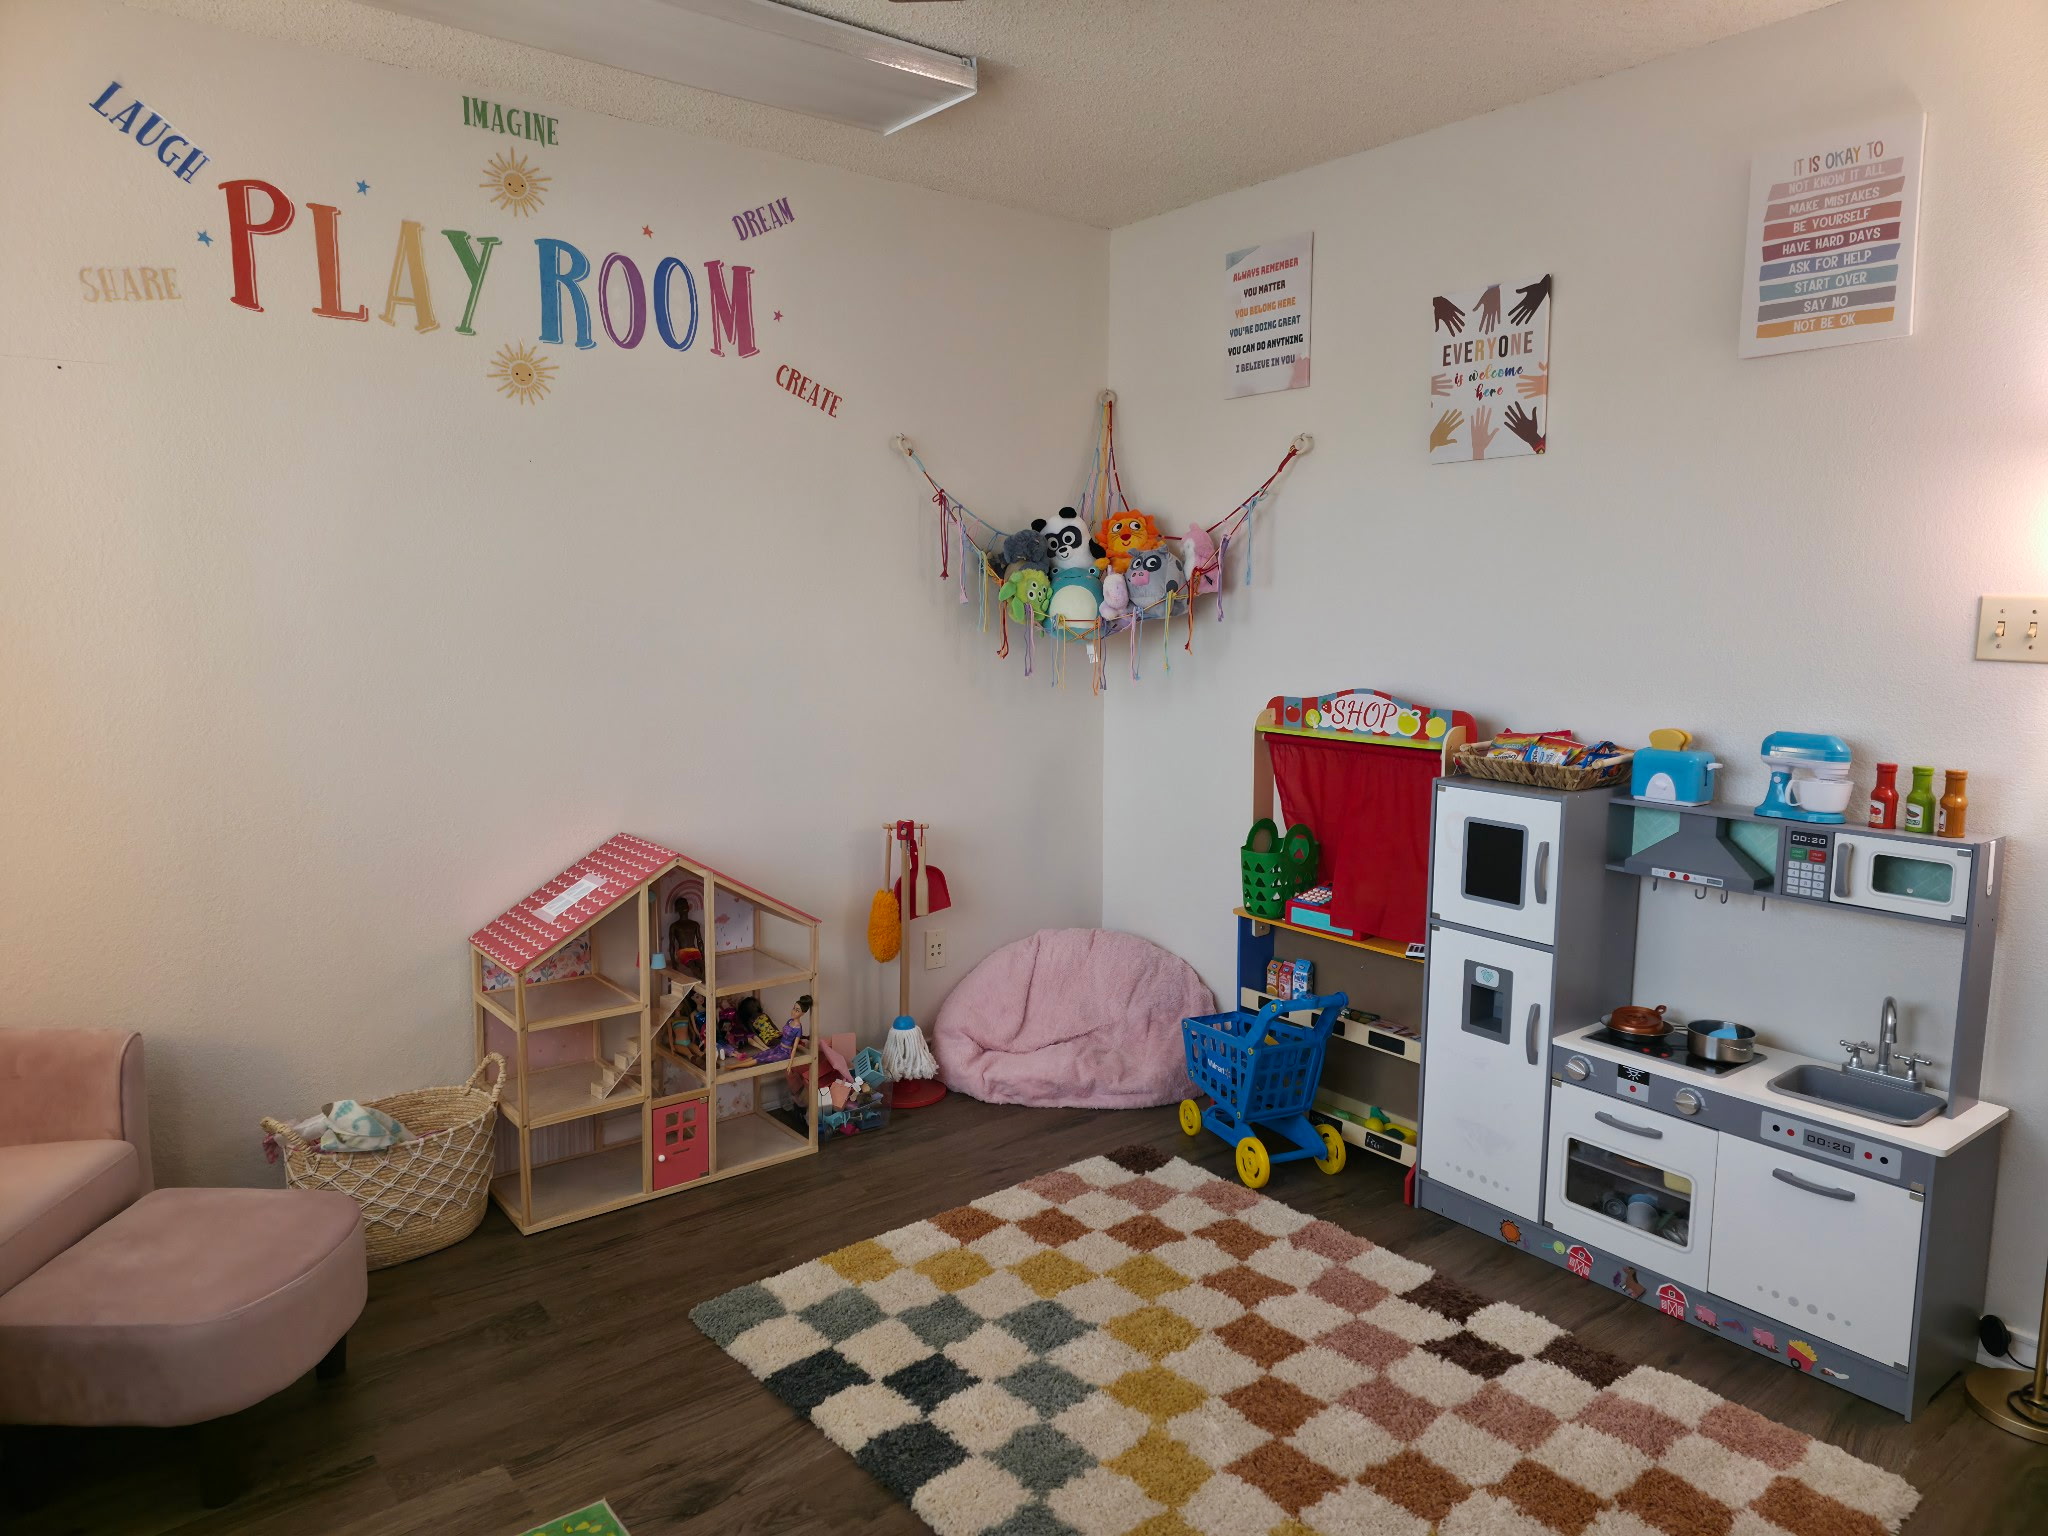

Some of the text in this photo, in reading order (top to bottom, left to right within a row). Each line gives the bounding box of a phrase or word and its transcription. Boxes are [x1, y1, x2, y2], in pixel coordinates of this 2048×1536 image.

[89, 81, 211, 184] LAUGH
[461, 94, 561, 149] IMAGINE
[1793, 140, 1884, 177] IT IS OKAY TO
[1789, 163, 1885, 195] NOT KNOW IT ALL
[1789, 186, 1880, 215] MAKE MISTAKES
[731, 197, 795, 241] DREAM
[1793, 207, 1871, 234] BE YOURSELF
[1782, 227, 1881, 255] HAVE HARD DAYS
[218, 178, 761, 360] PLAY ROOM
[1233, 257, 1299, 282] ALWAYS REMEMBER
[1789, 249, 1872, 275] ASK FOR HELP
[79, 266, 183, 304] SHARE
[1243, 279, 1286, 298] YOU MATTER
[1794, 271, 1867, 294] START OVER
[1235, 296, 1296, 319] YOU BELONG HERE
[1803, 295, 1849, 313] SAY NO
[1230, 314, 1301, 338] YOU'RE DOING GREAT
[1793, 312, 1856, 333] NOT BE OK
[1228, 333, 1304, 357] YOU CAN DO ANYTHING
[1442, 330, 1534, 367] EVERYONE
[1235, 354, 1296, 374] I BELIEVE IN YOU
[1455, 364, 1524, 387] is welcome
[776, 364, 843, 418] CREATE
[1474, 384, 1504, 401] here
[1331, 699, 1398, 729] SHOP
[1792, 834, 1826, 845] 00:20
[1807, 1134, 1851, 1154] 00:20
